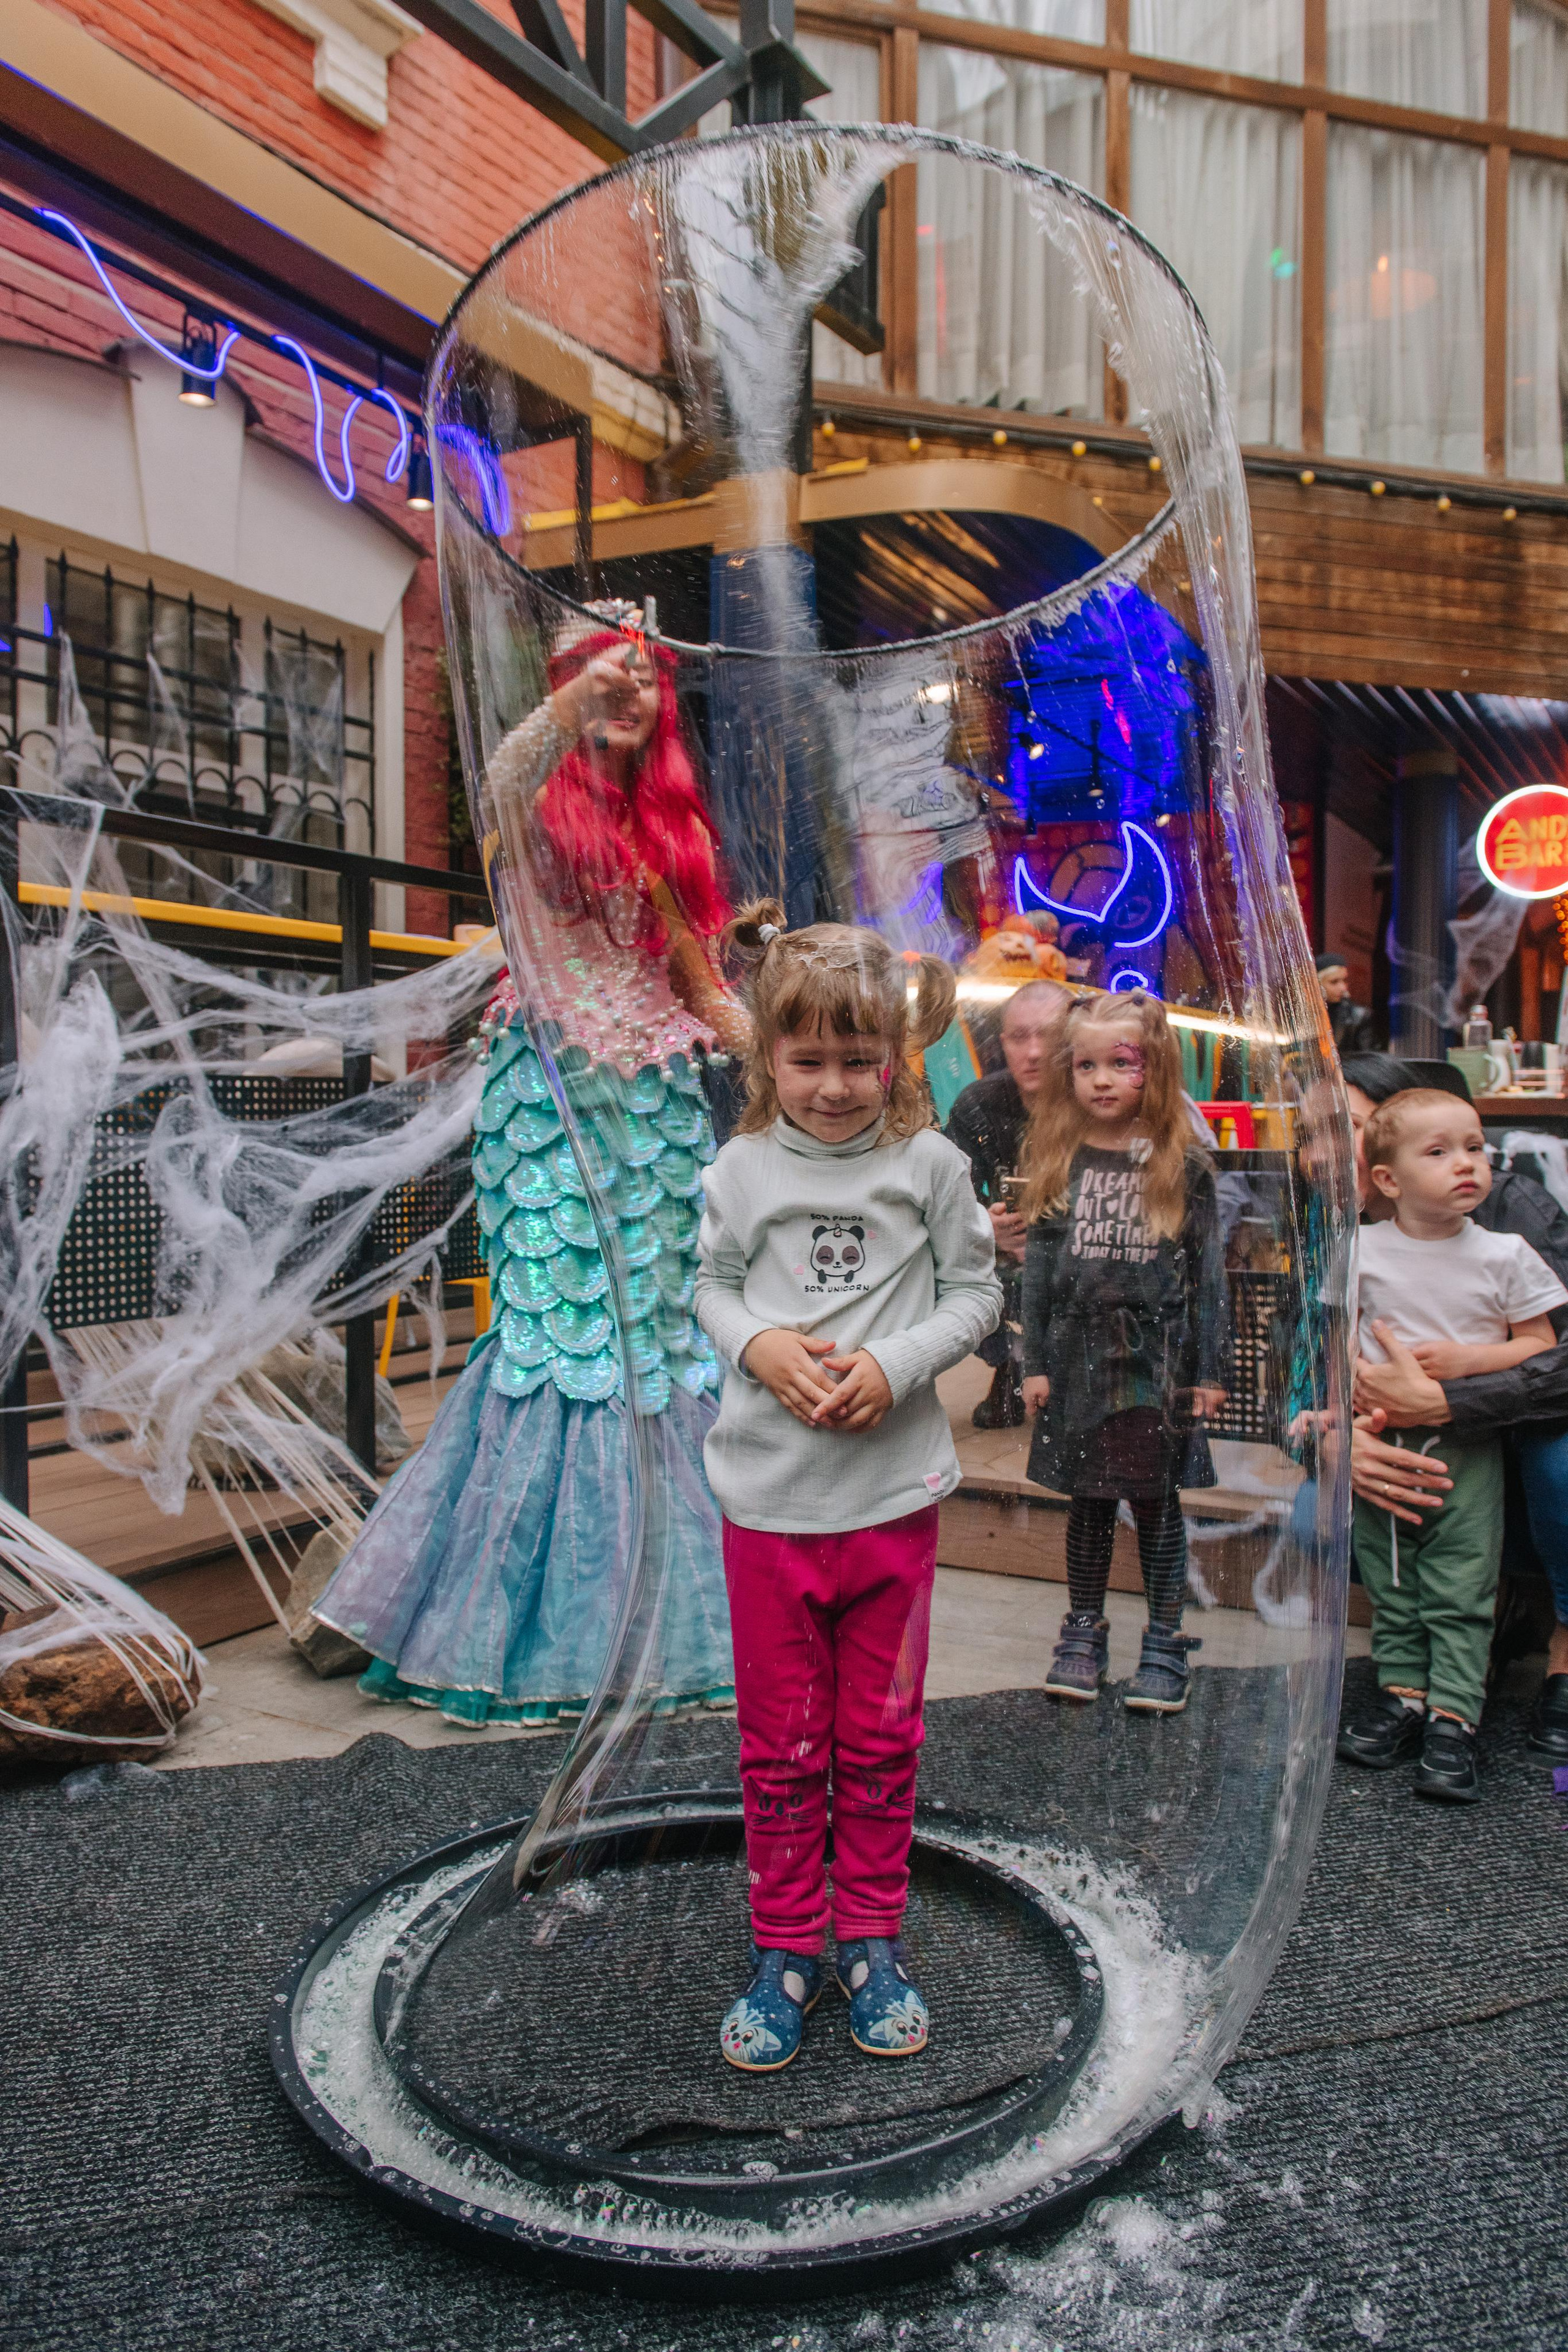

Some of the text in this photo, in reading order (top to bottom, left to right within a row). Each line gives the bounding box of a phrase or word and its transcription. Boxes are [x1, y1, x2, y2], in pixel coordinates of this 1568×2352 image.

[1495, 815, 1568, 844] AND
[1495, 840, 1568, 870] BAR
[1075, 1193, 1106, 1219] OUT
[1071, 1219, 1158, 1256] SOMETIME
[1112, 1248, 1122, 1260] IS
[828, 1284, 869, 1292] UNICORN
